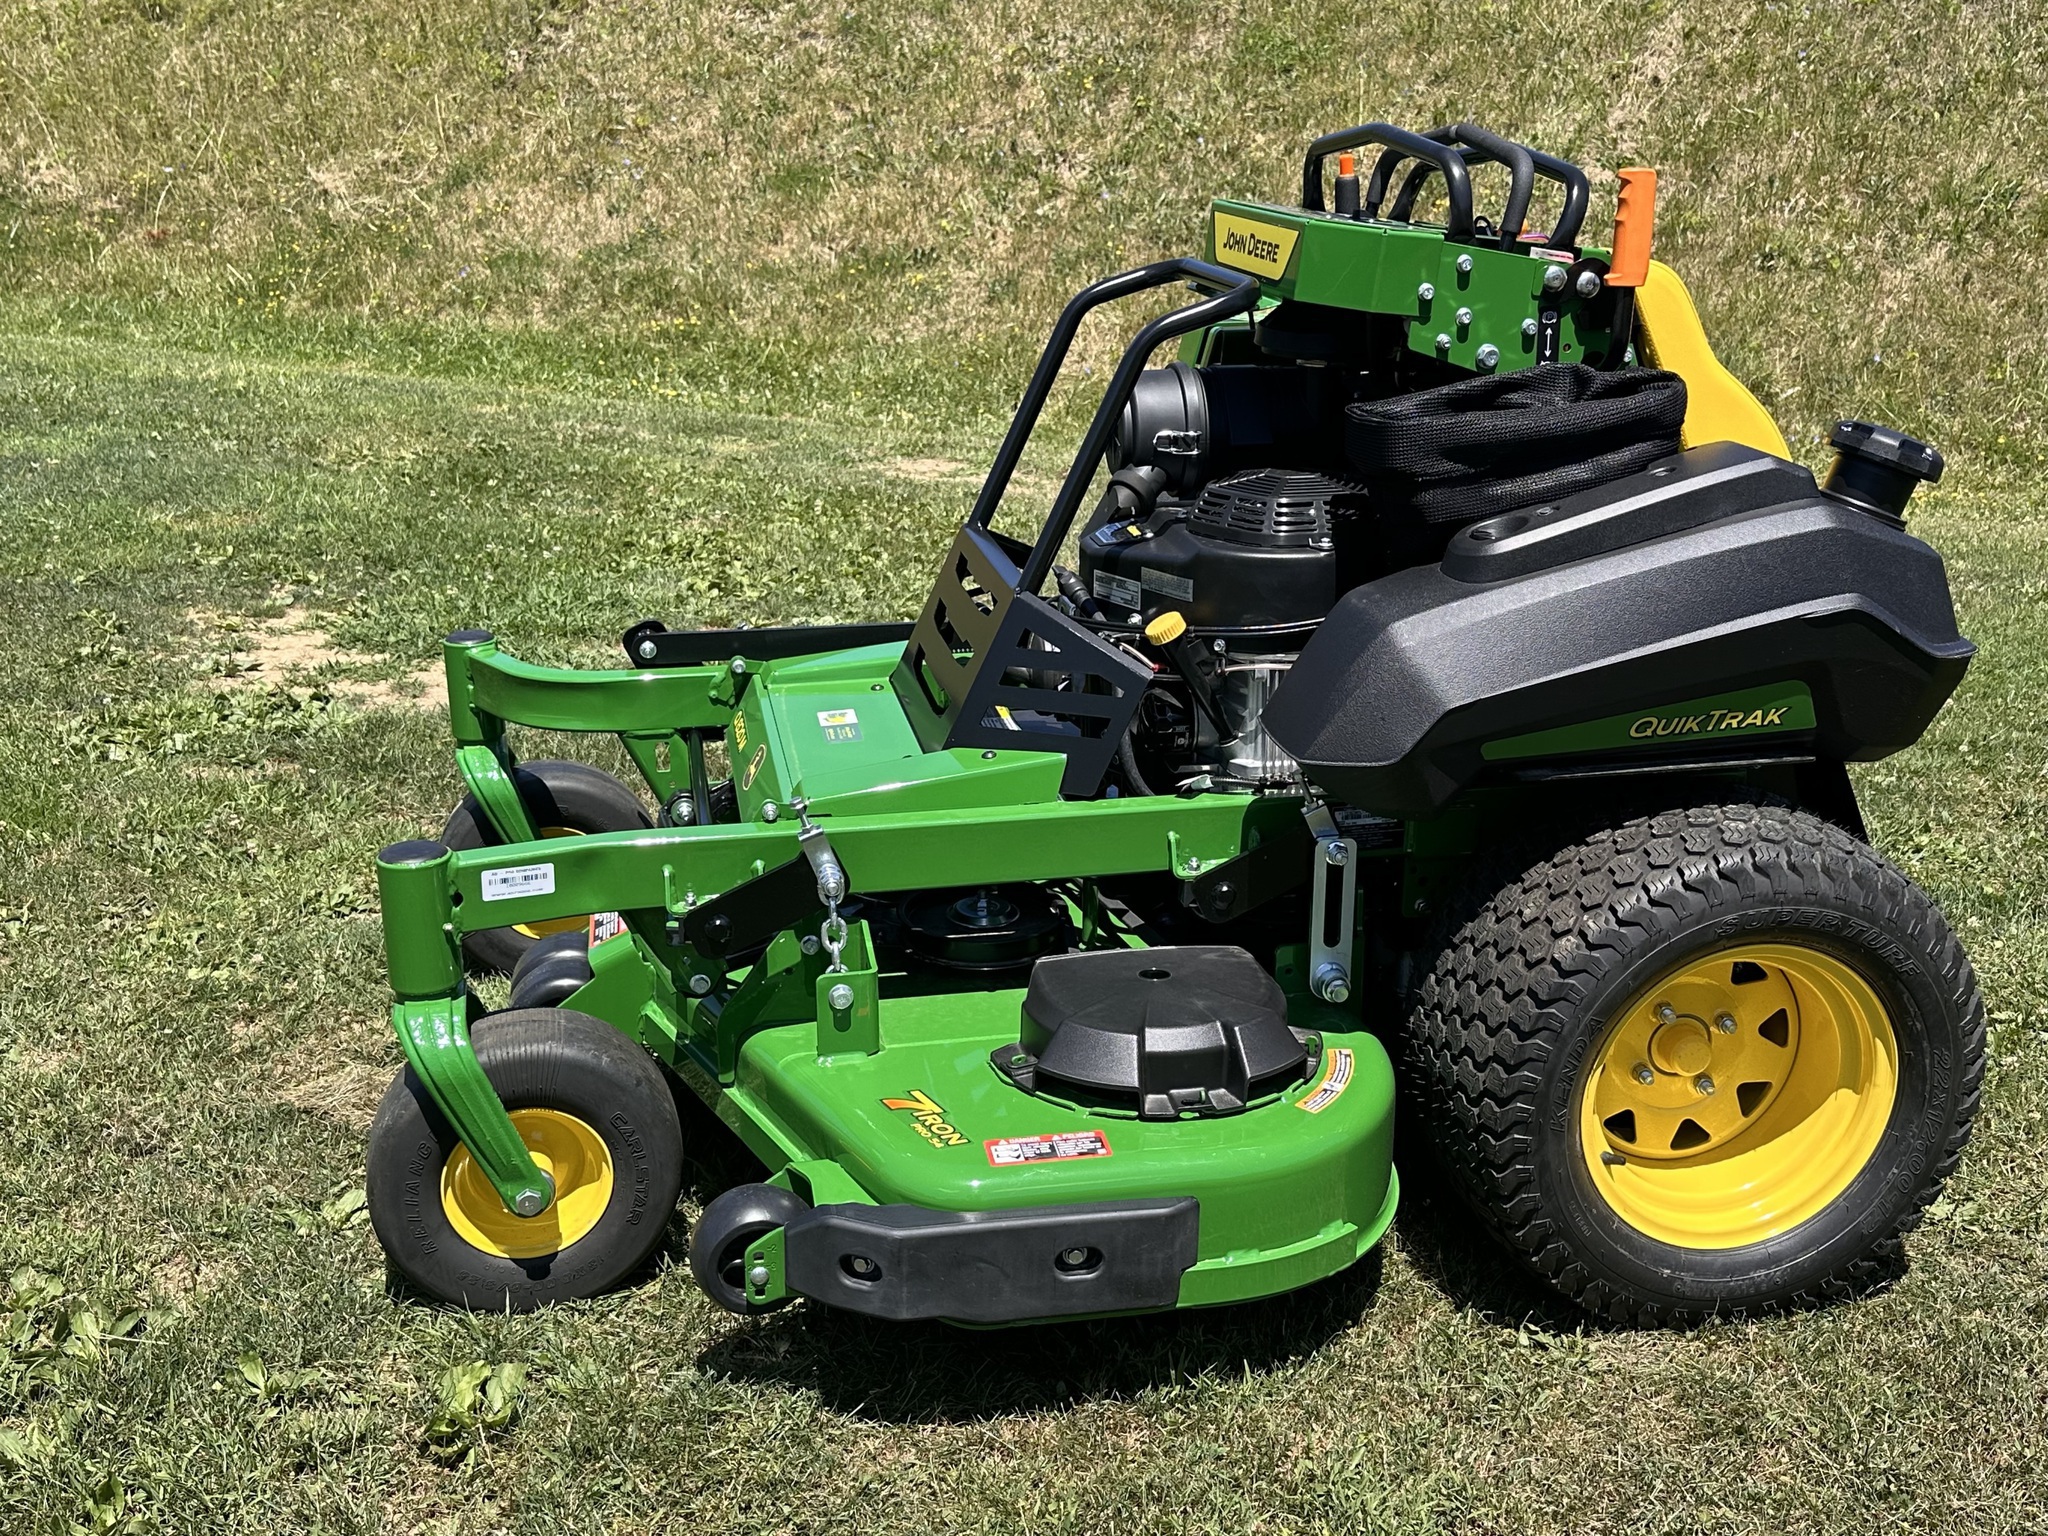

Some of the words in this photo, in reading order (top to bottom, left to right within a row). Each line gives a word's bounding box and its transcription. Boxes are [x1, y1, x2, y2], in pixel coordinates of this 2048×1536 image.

[1223, 227, 1248, 254] JOHN
[1247, 232, 1280, 264] DEERE
[1714, 907, 1843, 938] SUPER
[1842, 918, 1921, 977] TURF
[1549, 1015, 1606, 1133] KENDA
[609, 1111, 650, 1226] CARLSTAR
[909, 1122, 933, 1139] PRO
[404, 1130, 439, 1254] RELIANC
